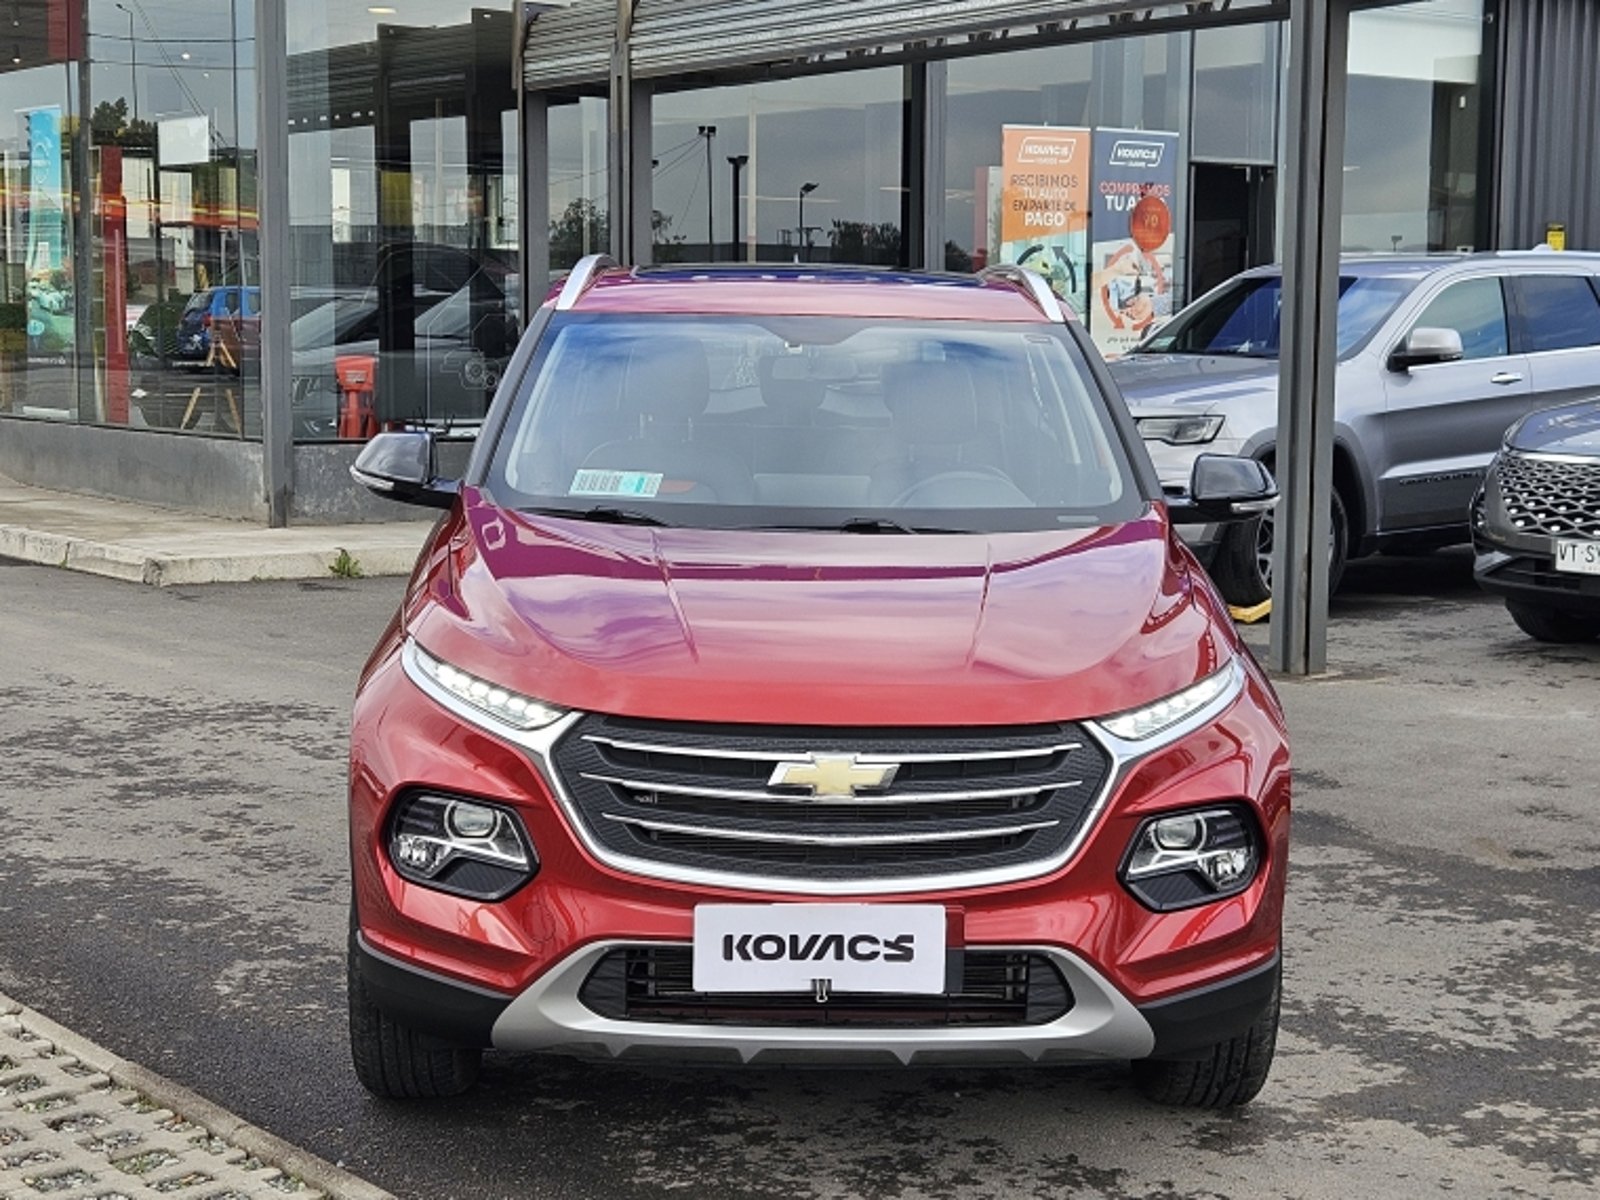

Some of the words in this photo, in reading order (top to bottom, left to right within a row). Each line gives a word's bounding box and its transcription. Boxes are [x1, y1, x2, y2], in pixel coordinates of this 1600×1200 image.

[1105, 195, 1124, 211] TU
[1024, 212, 1065, 226] PAGO
[722, 934, 914, 962] KOVACS
